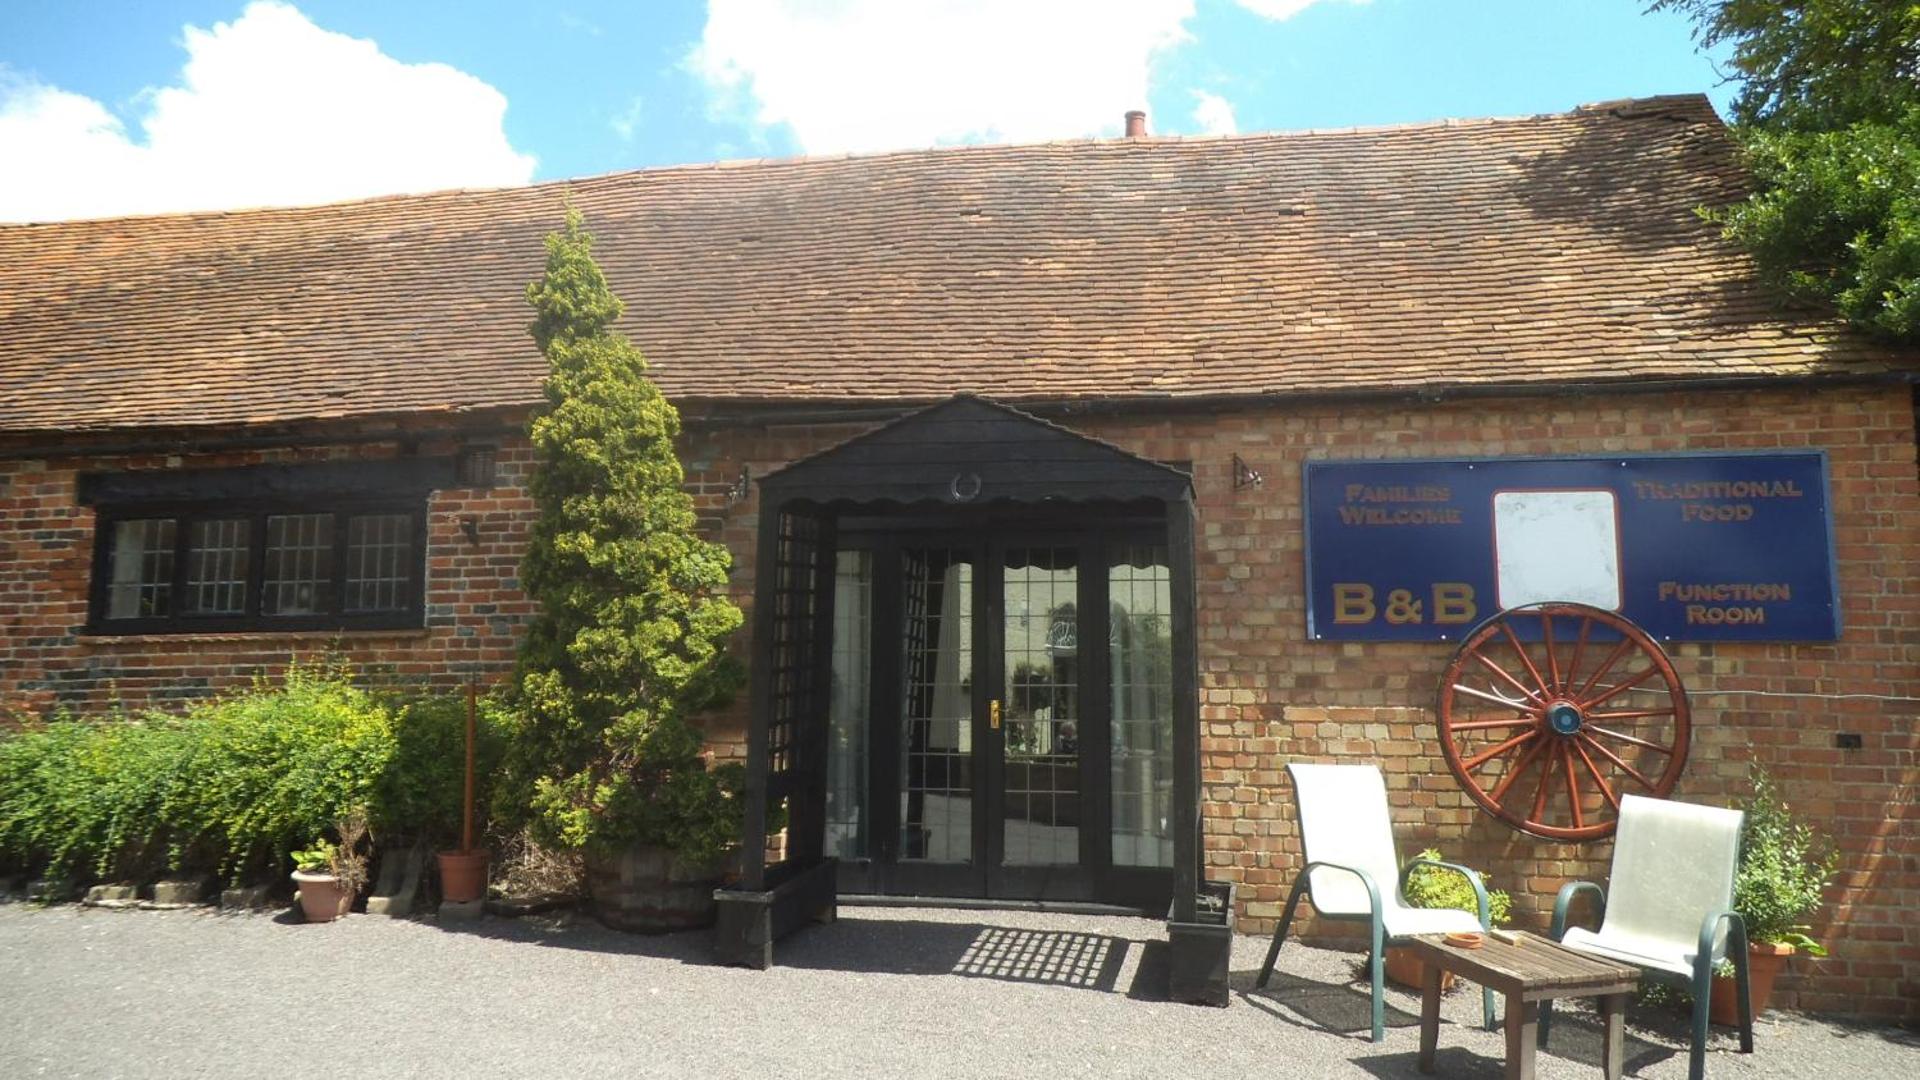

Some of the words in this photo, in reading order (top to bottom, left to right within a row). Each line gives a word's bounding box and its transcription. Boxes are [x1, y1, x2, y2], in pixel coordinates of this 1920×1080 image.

[1633, 480, 1803, 500] TRADITIONAL
[1339, 505, 1463, 525] WELCOME
[1681, 503, 1754, 522] FOOD
[1658, 581, 1790, 601] FUNCTION
[1686, 605, 1765, 625] ROOM
